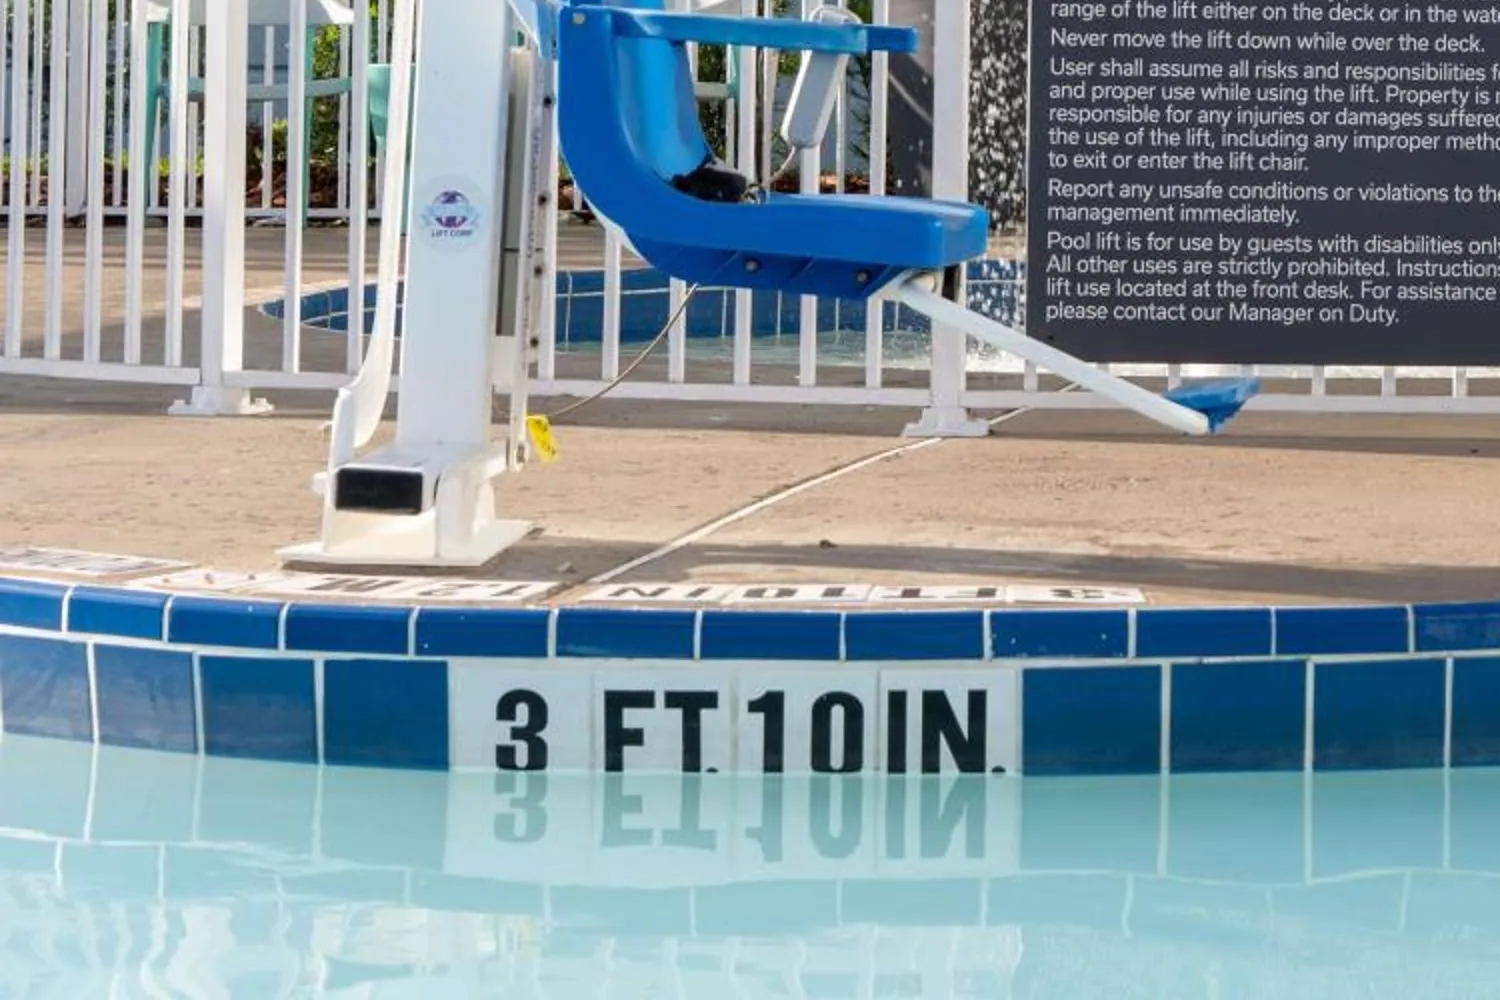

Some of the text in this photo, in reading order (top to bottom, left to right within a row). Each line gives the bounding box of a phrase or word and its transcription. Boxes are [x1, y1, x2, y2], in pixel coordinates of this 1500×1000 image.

[1050, 27, 1485, 53] Never move the lift down while over the deck.
[1050, 56, 1096, 77] User
[1100, 57, 1144, 77] shall
[1148, 62, 1224, 78] assume
[1228, 59, 1250, 79] all
[1254, 59, 1299, 79] risks
[1302, 60, 1340, 80] and
[1344, 61, 1487, 84] responsibilities
[1048, 80, 1086, 100] and
[1091, 85, 1157, 103] proper
[1161, 86, 1196, 101] use
[1200, 82, 1252, 102] while
[1256, 82, 1309, 107] using
[1313, 83, 1345, 103] the
[1349, 83, 1380, 104] lift.
[1385, 83, 1470, 110] Property
[1474, 85, 1491, 105] is
[1049, 103, 1161, 126] responsible
[1164, 103, 1193, 124] for
[1197, 108, 1233, 129] any
[1236, 105, 1305, 129] injuries
[1309, 111, 1331, 126] or
[1334, 106, 1424, 131] damages
[1047, 126, 1080, 146] the
[1085, 130, 1120, 146] use
[1124, 126, 1145, 146] of
[1149, 126, 1182, 147] the
[1186, 127, 1216, 150] lift,
[1221, 127, 1309, 153] including
[1313, 133, 1349, 153] any
[1353, 129, 1441, 153] improper
[1047, 149, 1309, 172] to exit or enter the lift chair.
[1048, 177, 1114, 202] Report
[1119, 183, 1154, 203] any
[1158, 179, 1224, 200] unsafe
[1228, 180, 1329, 201] conditions
[1332, 186, 1355, 201] or
[1358, 182, 1449, 202] violations
[1453, 184, 1474, 203] to
[1046, 230, 1091, 251] Pool
[1096, 230, 1121, 251] lift
[1126, 231, 1142, 252] is
[1146, 231, 1175, 252] for
[1178, 236, 1214, 252] use
[1218, 232, 1242, 256] by
[1246, 235, 1313, 257] guests
[1317, 233, 1359, 254] with
[1363, 234, 1464, 255] disabilities
[1045, 253, 1071, 273] All
[1076, 254, 1129, 274] other
[1132, 259, 1178, 275] uses
[1182, 259, 1214, 275] are
[1217, 255, 1284, 280] strictly
[1287, 256, 1390, 279] prohibited.
[1046, 276, 1071, 297] lift
[1076, 282, 1111, 297] use
[1116, 277, 1187, 298] located
[1191, 279, 1212, 298] at
[1215, 279, 1248, 299] the
[1252, 279, 1299, 299] front
[1303, 279, 1354, 300] desk.
[1360, 279, 1393, 300] For
[1396, 281, 1497, 301] assistance
[1045, 300, 1399, 327] please contact our Manager on Duty.
[494, 688, 549, 773] 3
[746, 689, 864, 774] 10
[886, 689, 1007, 774] IN.
